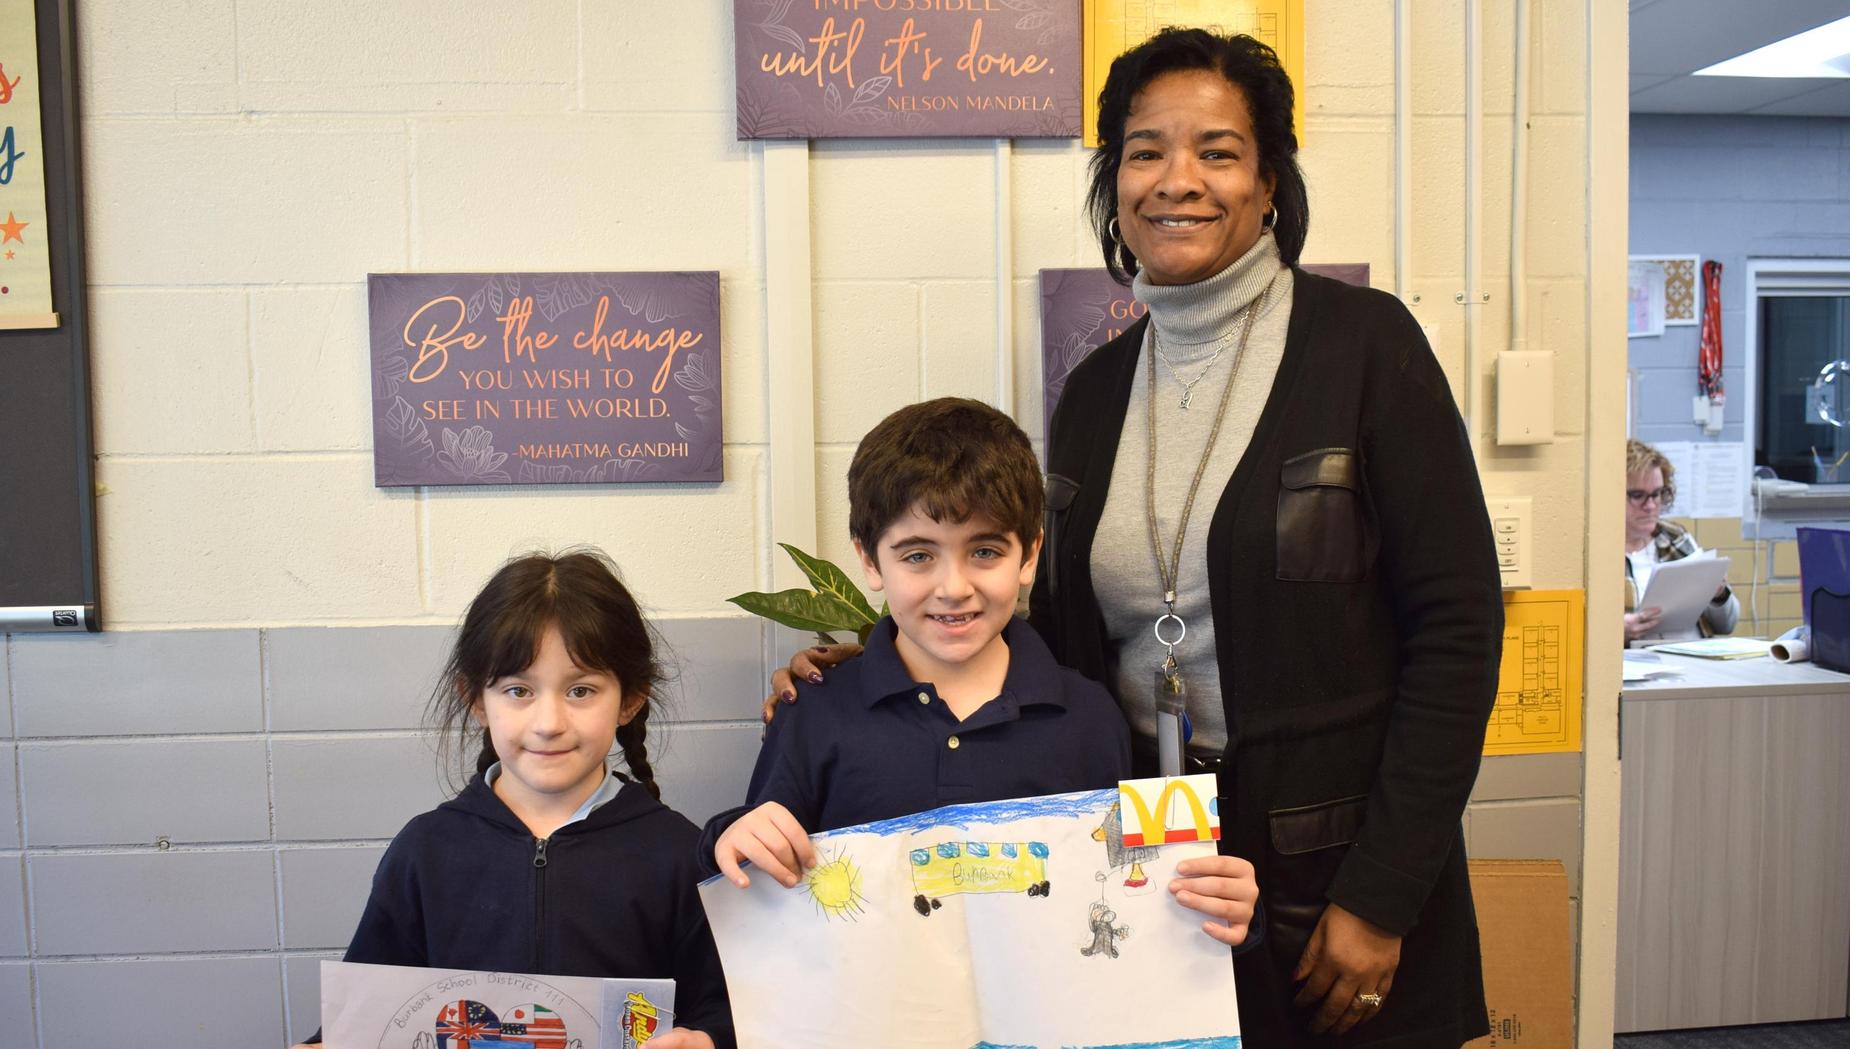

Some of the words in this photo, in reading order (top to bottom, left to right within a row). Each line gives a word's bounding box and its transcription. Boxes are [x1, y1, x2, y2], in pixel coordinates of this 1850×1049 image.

[761, 17, 865, 88] until
[880, 18, 943, 88] it's
[957, 18, 1055, 82] done.
[887, 95, 959, 112] NELSON
[966, 95, 1055, 112] MANDELA
[403, 296, 488, 383] Be
[496, 296, 559, 363] the
[573, 296, 703, 393] change
[458, 369, 514, 390] YOU
[522, 369, 591, 390] WISH
[603, 368, 634, 389] TO
[422, 399, 467, 421] SEE
[475, 399, 500, 419] IN
[510, 399, 559, 419] THE
[566, 397, 671, 418] WORLD.
[512, 443, 613, 459] -MAHATMA
[617, 442, 689, 458] GANDHI
[437, 978, 478, 993] School
[487, 973, 540, 992] District
